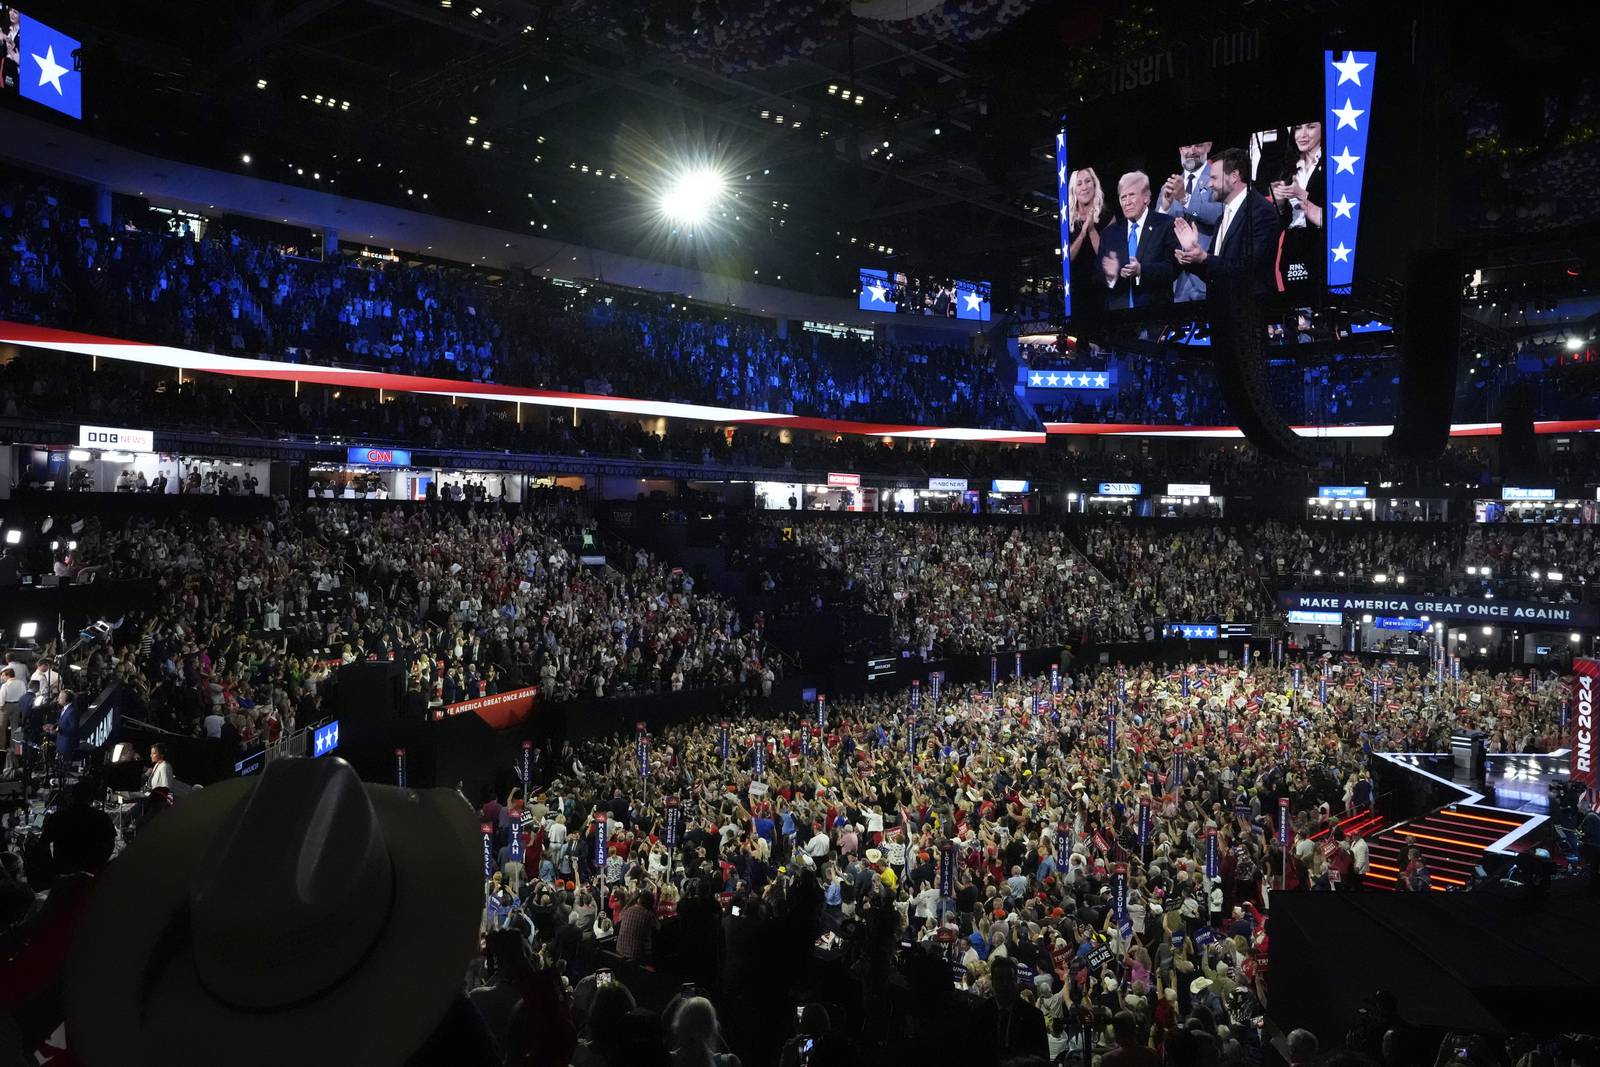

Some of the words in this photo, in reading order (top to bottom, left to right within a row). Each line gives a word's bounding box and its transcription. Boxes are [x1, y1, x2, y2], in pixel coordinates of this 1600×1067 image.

[1287, 270, 1308, 278] 2024
[88, 432, 118, 443] BBC
[121, 435, 146, 445] NEWS
[367, 449, 393, 464] CNN
[1300, 598, 1340, 609] MAKE
[1344, 599, 1409, 612] AMERICA
[1414, 602, 1462, 614] GREAT
[1467, 604, 1509, 616] ONCE
[1514, 607, 1571, 620] AGAIN!
[455, 702, 482, 714] AMERICA
[483, 696, 502, 708] GREAT
[502, 693, 518, 703] ONCE
[1578, 675, 1592, 729] 2024
[1577, 730, 1592, 773] RNC
[1090, 950, 1111, 967] BLUE
